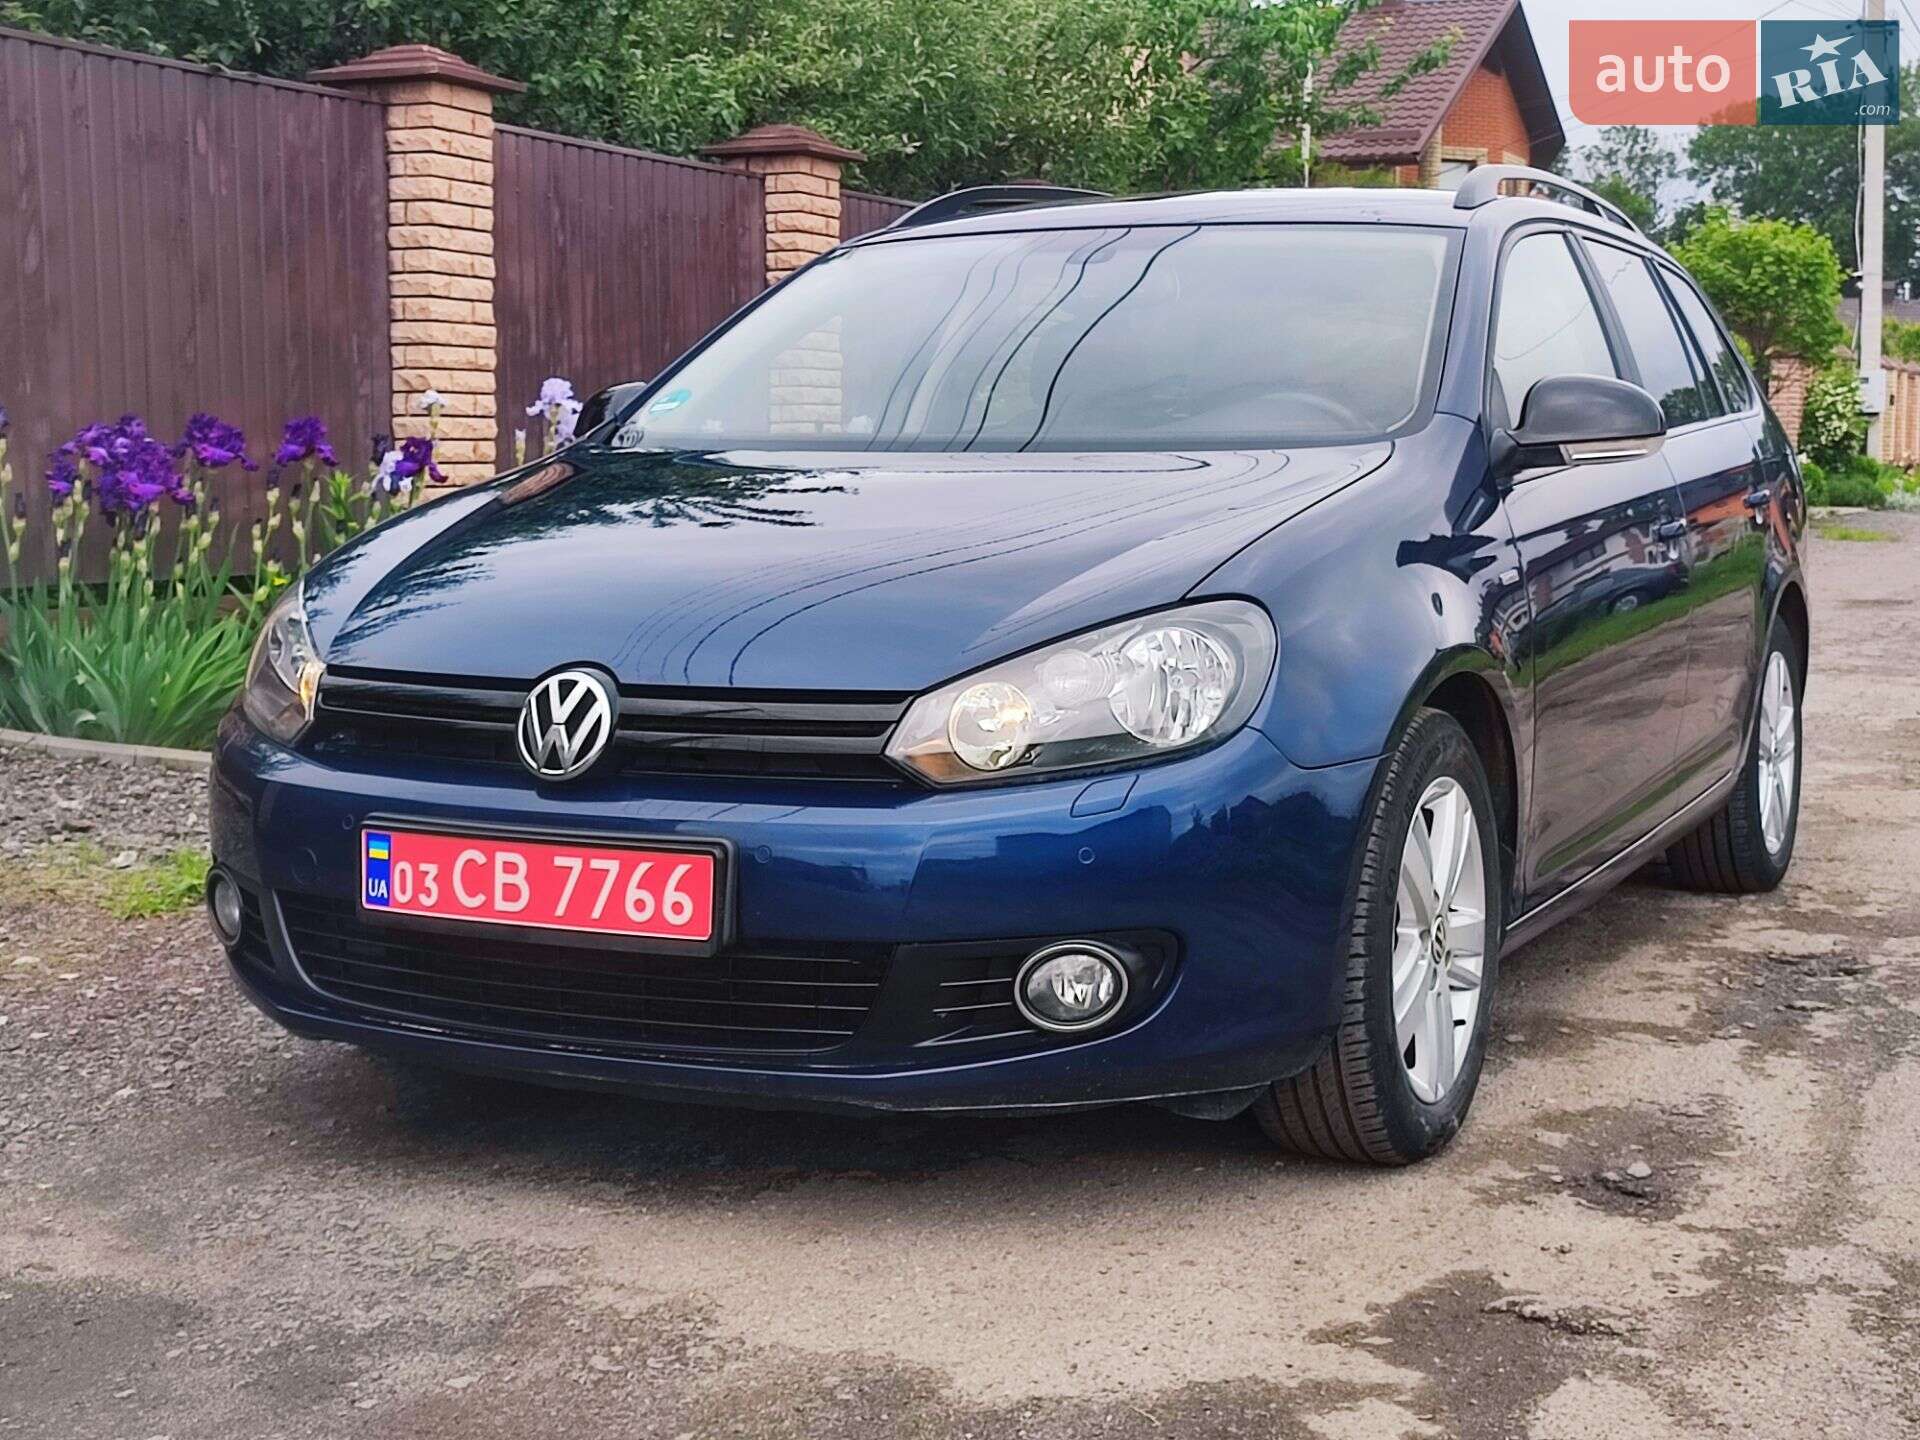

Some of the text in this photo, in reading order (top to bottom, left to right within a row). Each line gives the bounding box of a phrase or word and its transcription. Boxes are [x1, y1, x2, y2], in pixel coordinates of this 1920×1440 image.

[368, 877, 388, 899] UA
[393, 848, 694, 926] 03 CB 7766
